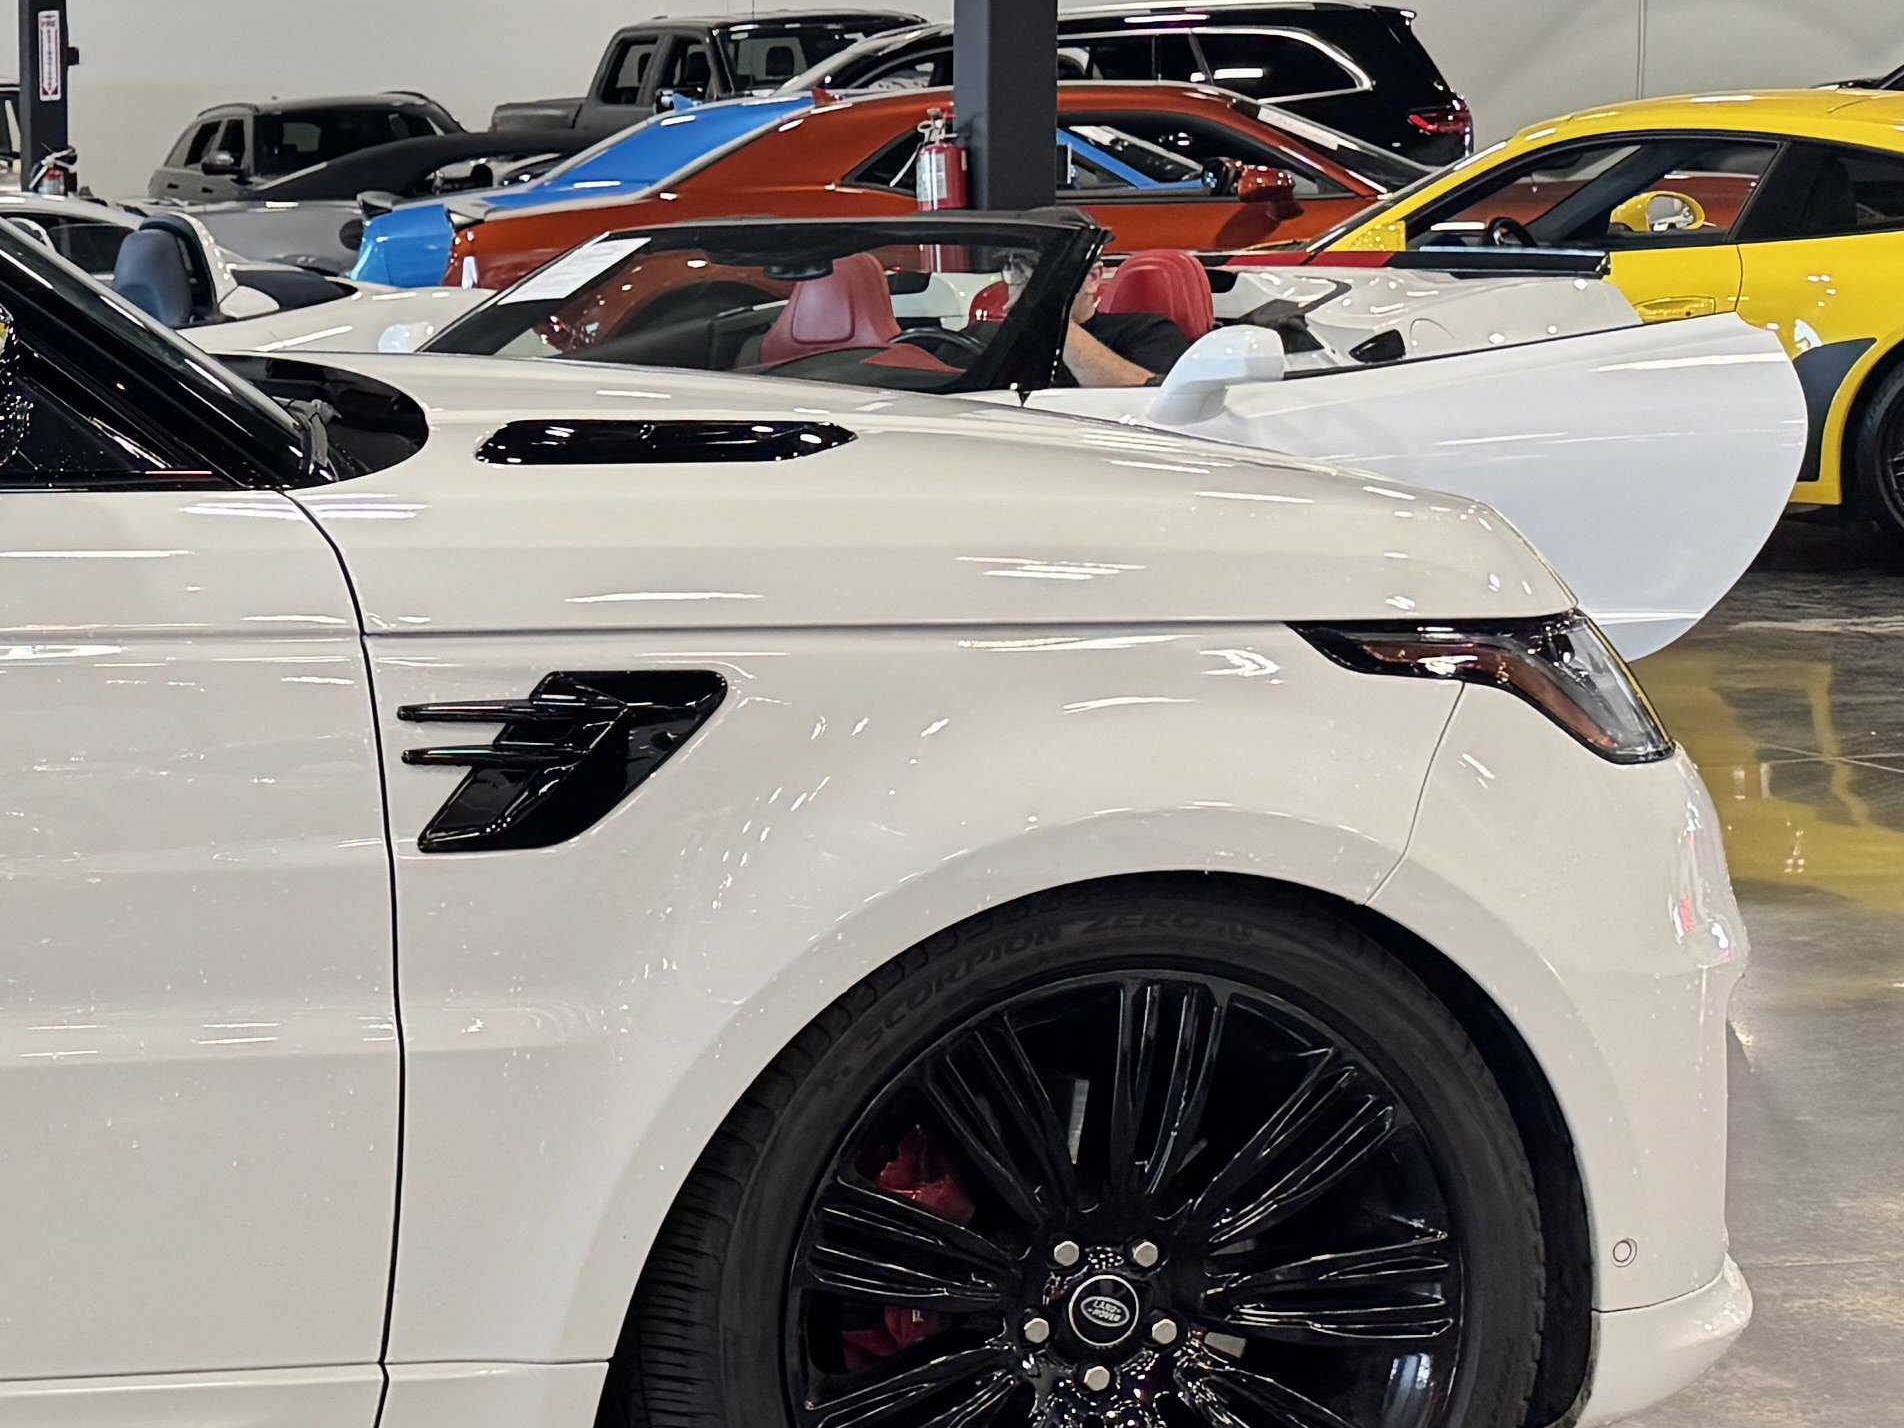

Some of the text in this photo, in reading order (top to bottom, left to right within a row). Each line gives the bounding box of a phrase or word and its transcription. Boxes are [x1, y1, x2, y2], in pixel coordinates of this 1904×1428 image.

[863, 912, 1204, 1051] SCORPION ZERO
[1092, 1300, 1118, 1314] LAND
